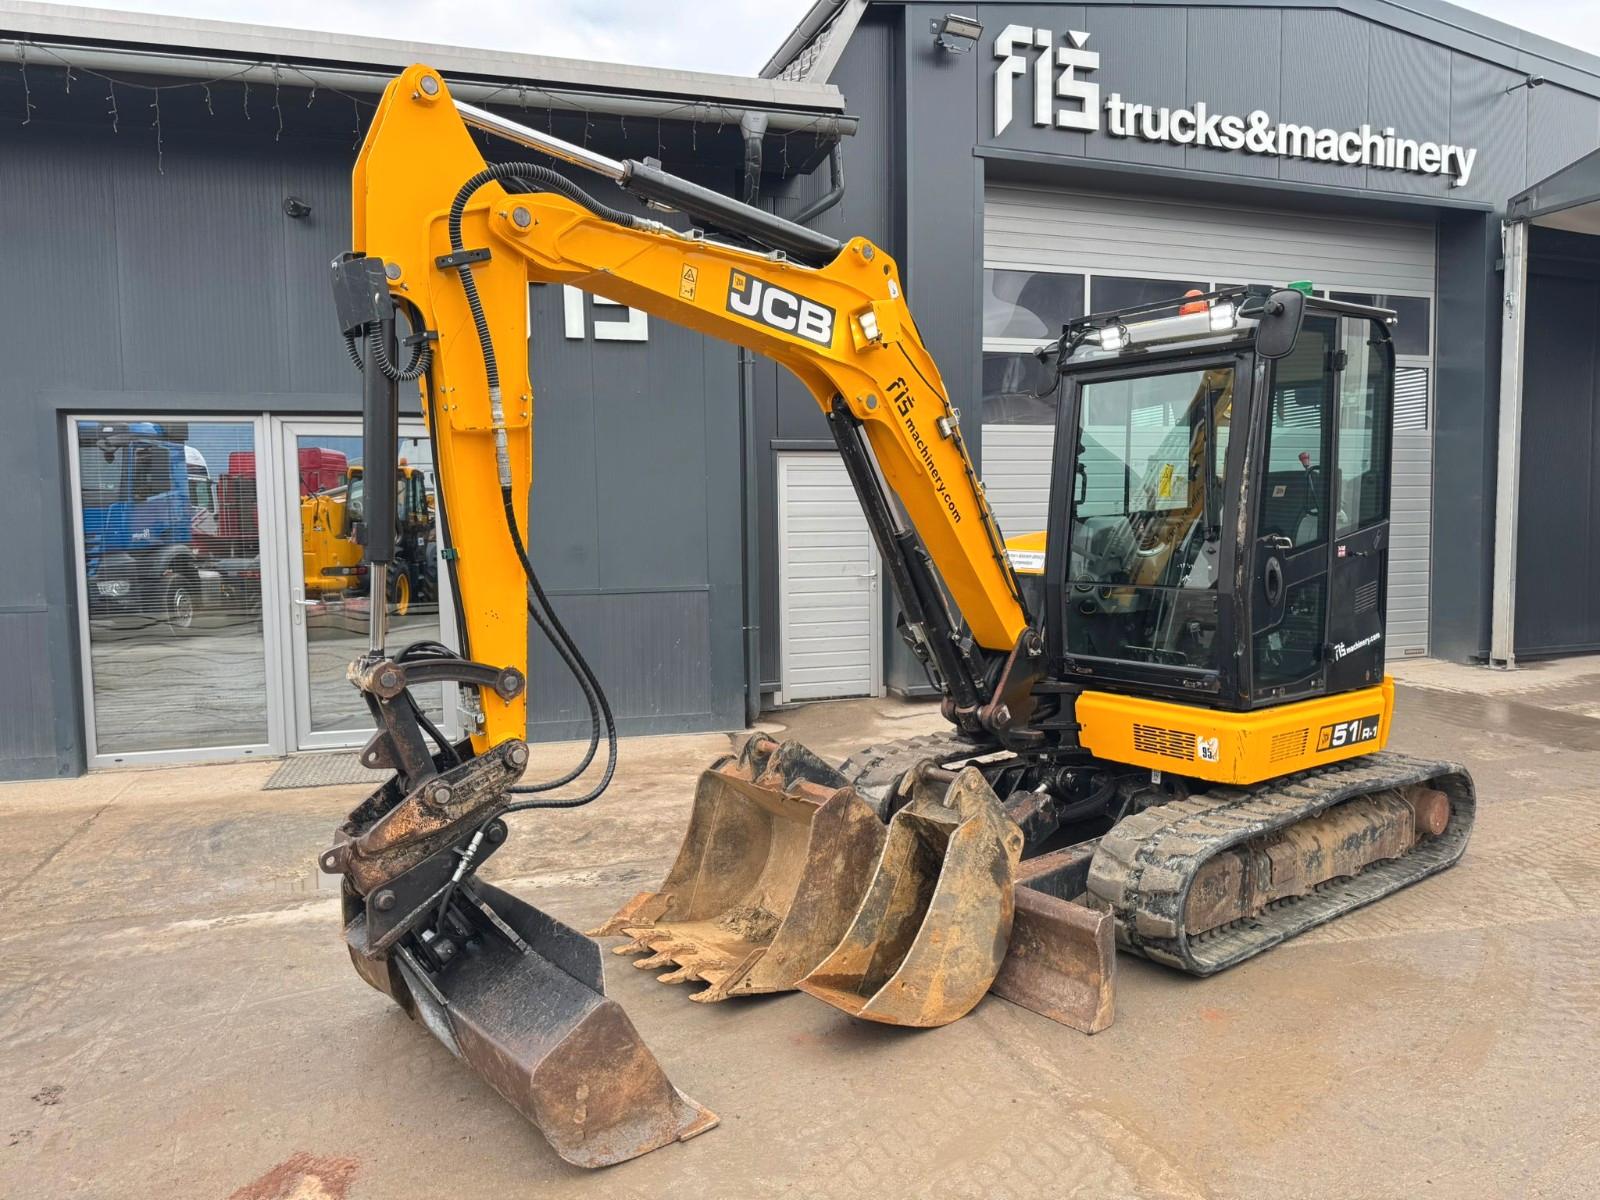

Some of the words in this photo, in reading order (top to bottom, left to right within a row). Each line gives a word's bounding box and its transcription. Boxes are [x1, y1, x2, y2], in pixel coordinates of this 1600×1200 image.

[1104, 92, 1477, 187] trucks&machinery
[730, 279, 832, 343] JCB
[904, 417, 962, 524] machinery.com
[1332, 720, 1360, 747] 51
